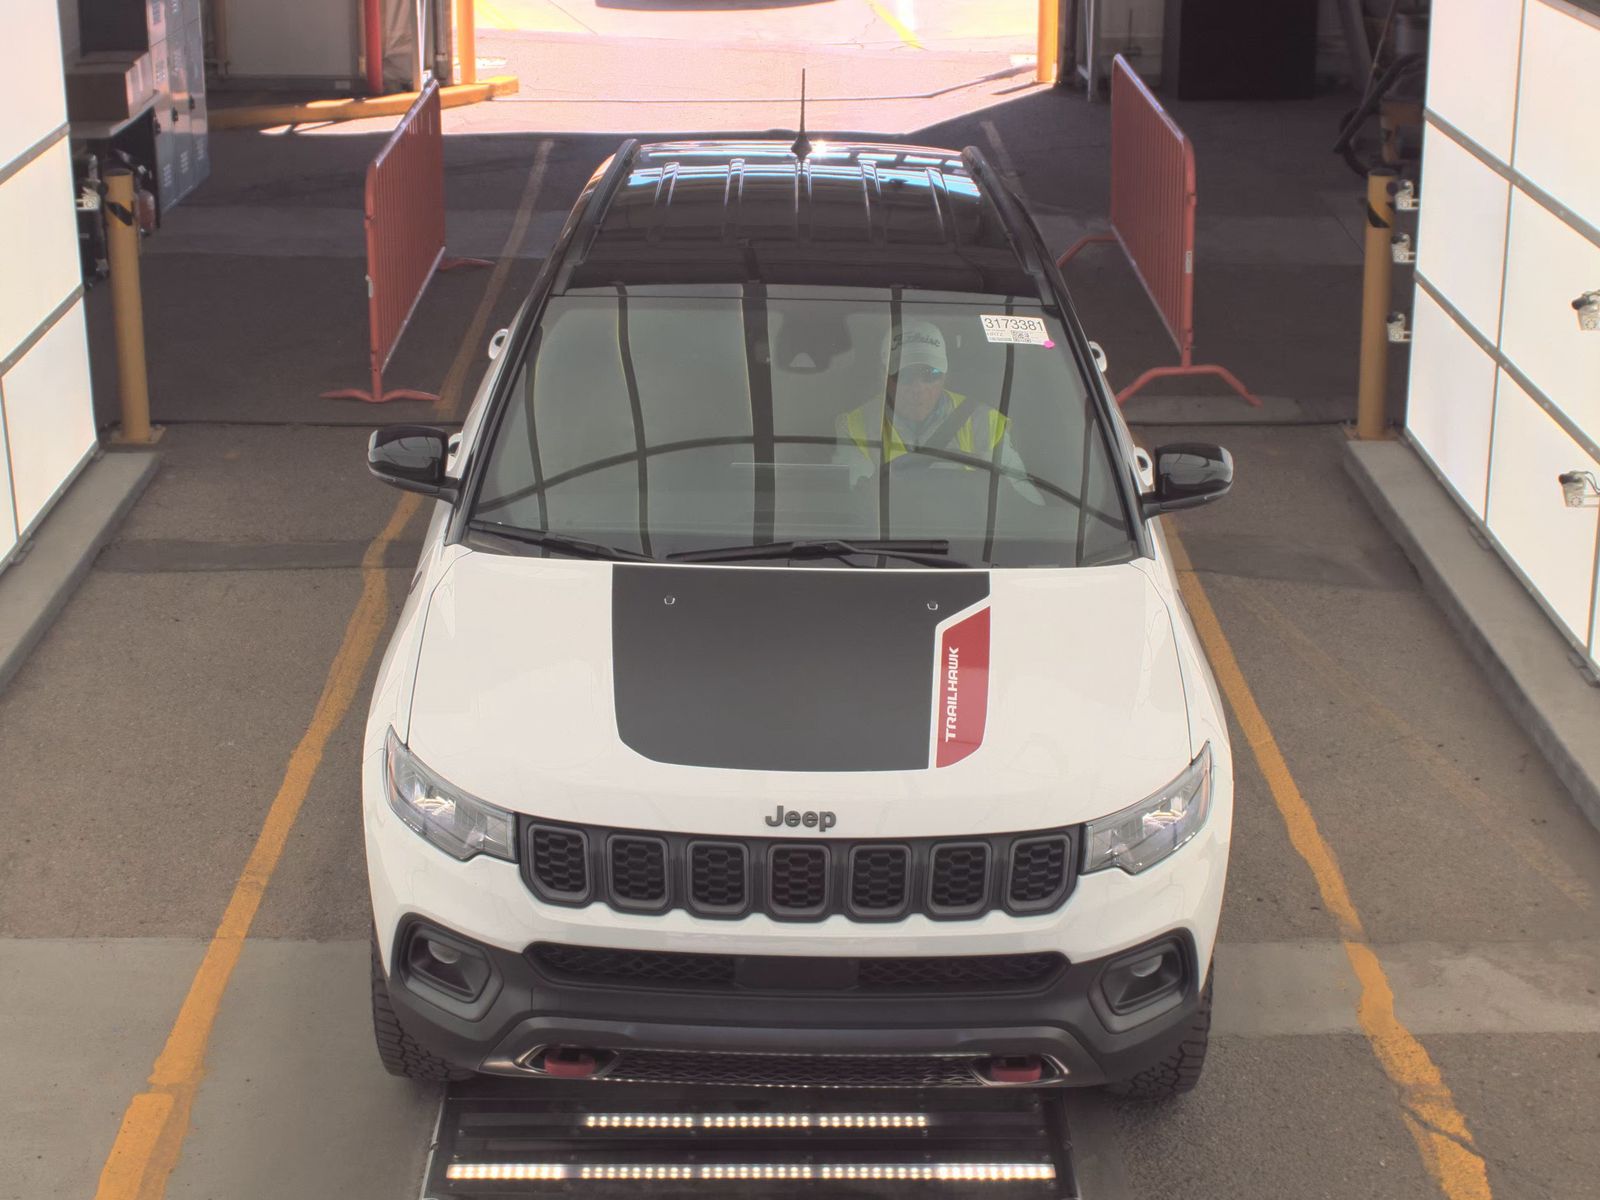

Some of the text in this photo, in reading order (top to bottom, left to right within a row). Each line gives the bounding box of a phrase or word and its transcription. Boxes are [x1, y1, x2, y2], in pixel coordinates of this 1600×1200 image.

[984, 317, 1043, 332] 3173381
[945, 646, 960, 743] TRAILHAWK
[765, 805, 837, 832] Jeep
